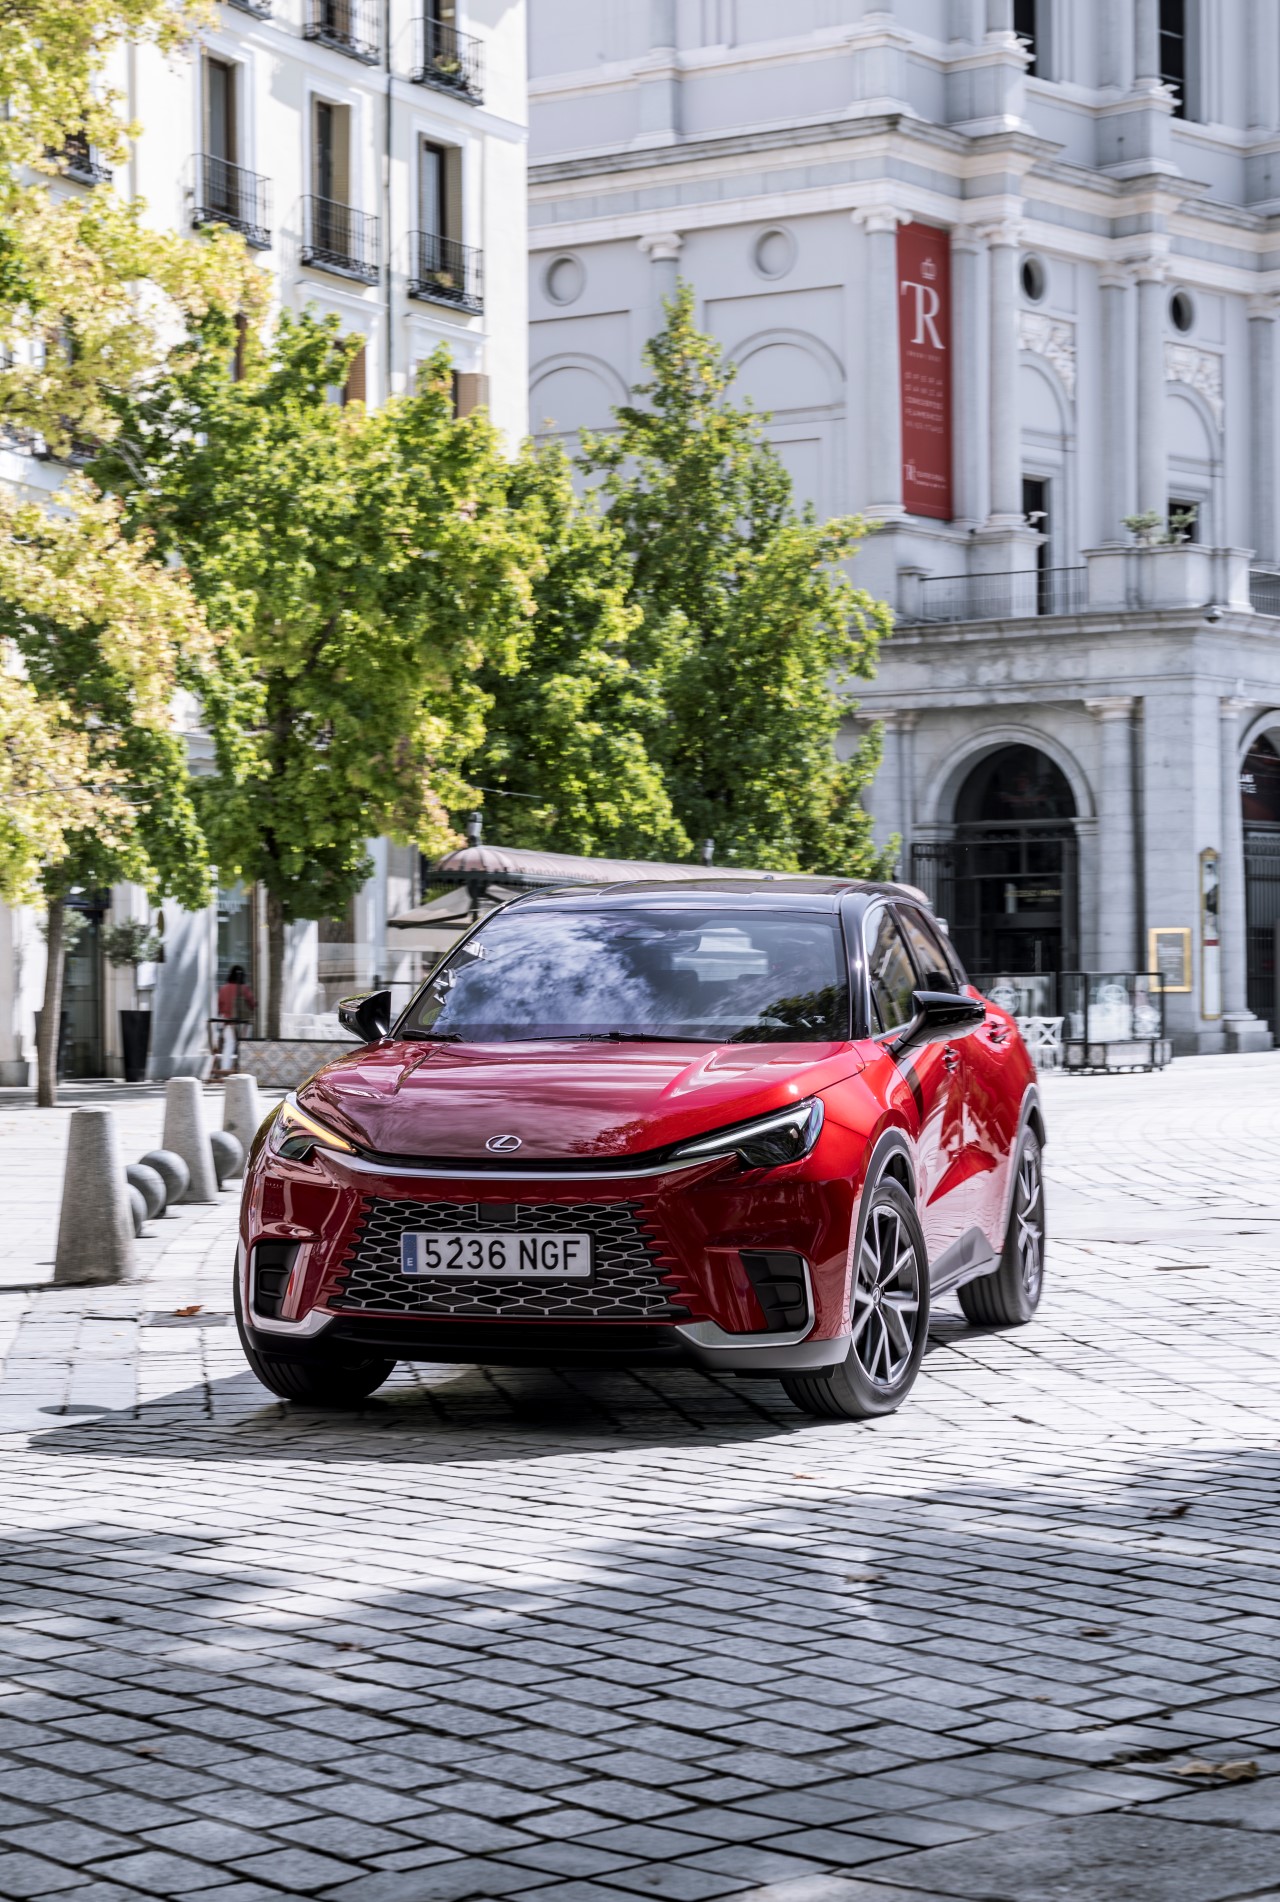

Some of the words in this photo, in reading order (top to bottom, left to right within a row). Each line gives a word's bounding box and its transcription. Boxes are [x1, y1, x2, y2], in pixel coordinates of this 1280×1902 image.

[406, 1257, 414, 1267] E
[425, 1238, 506, 1270] 5236
[519, 1238, 581, 1271] NGF
